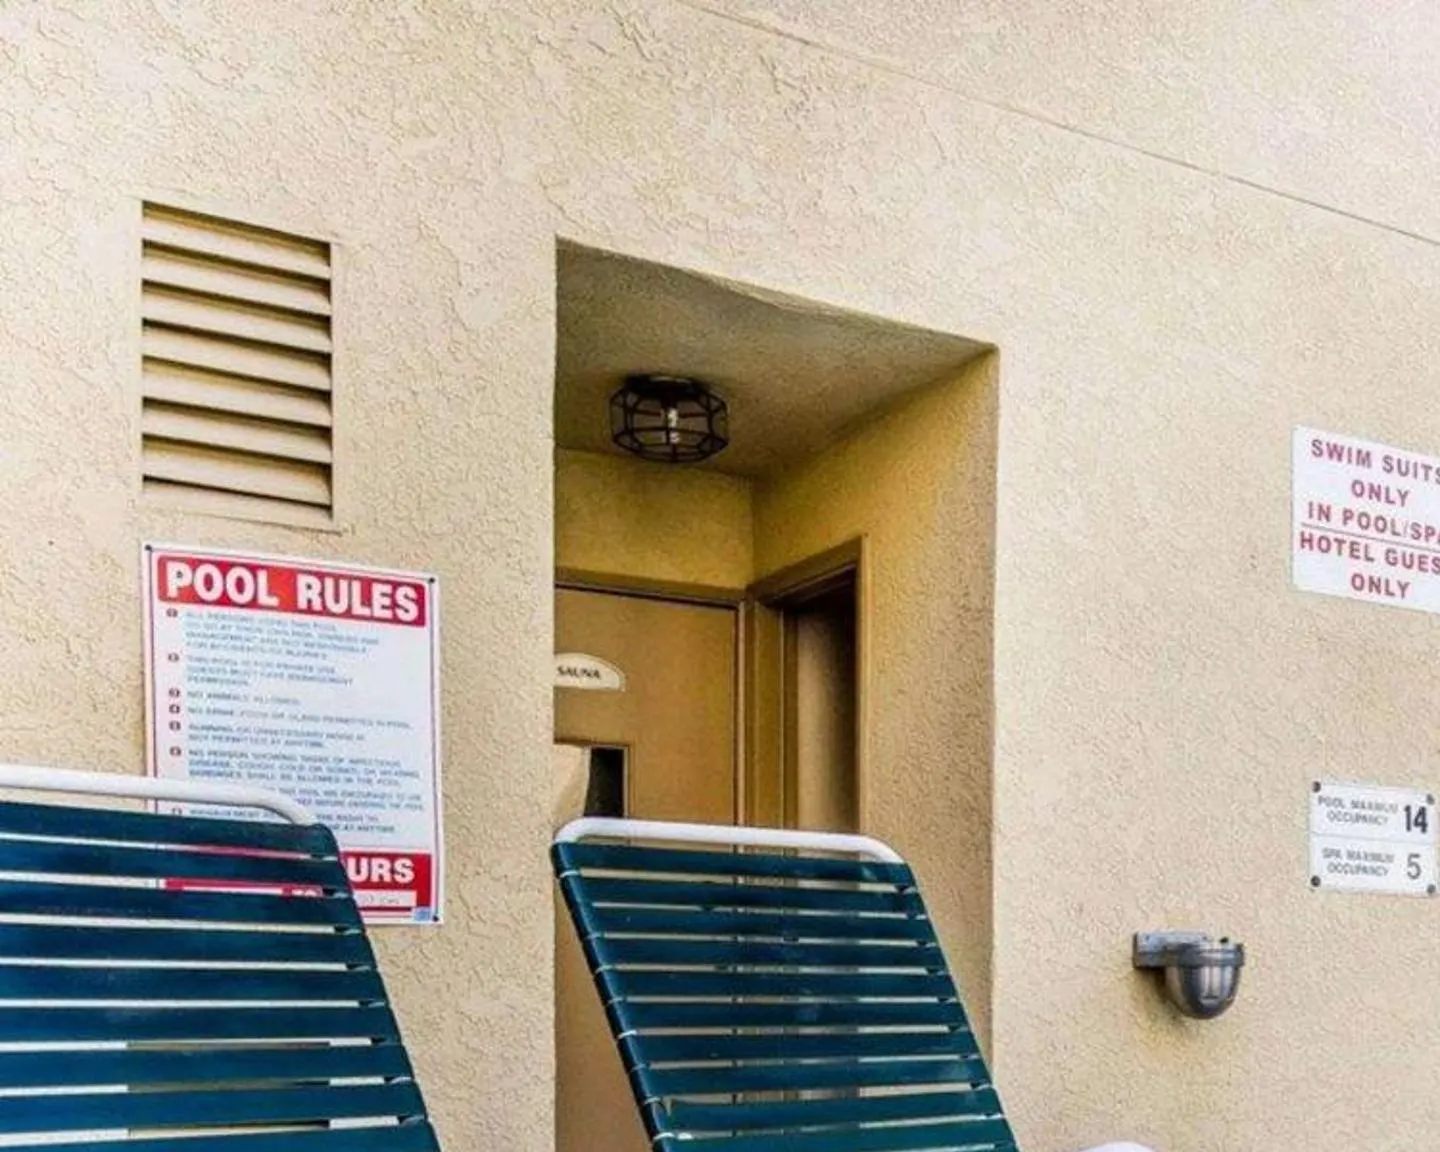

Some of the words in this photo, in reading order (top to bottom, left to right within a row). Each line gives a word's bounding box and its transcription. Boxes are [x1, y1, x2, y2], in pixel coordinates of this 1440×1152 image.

[1310, 438, 1373, 470] SWIM
[1351, 479, 1411, 508] ONLY
[1307, 501, 1333, 523] IN
[1299, 531, 1376, 563] HOTEL
[166, 560, 280, 606] POOL
[295, 573, 420, 623] RULES
[1351, 572, 1412, 600] ONLY
[556, 665, 602, 680] SAUNA
[1404, 804, 1429, 834] 14
[346, 856, 416, 885] URS
[1406, 852, 1423, 881] 5
